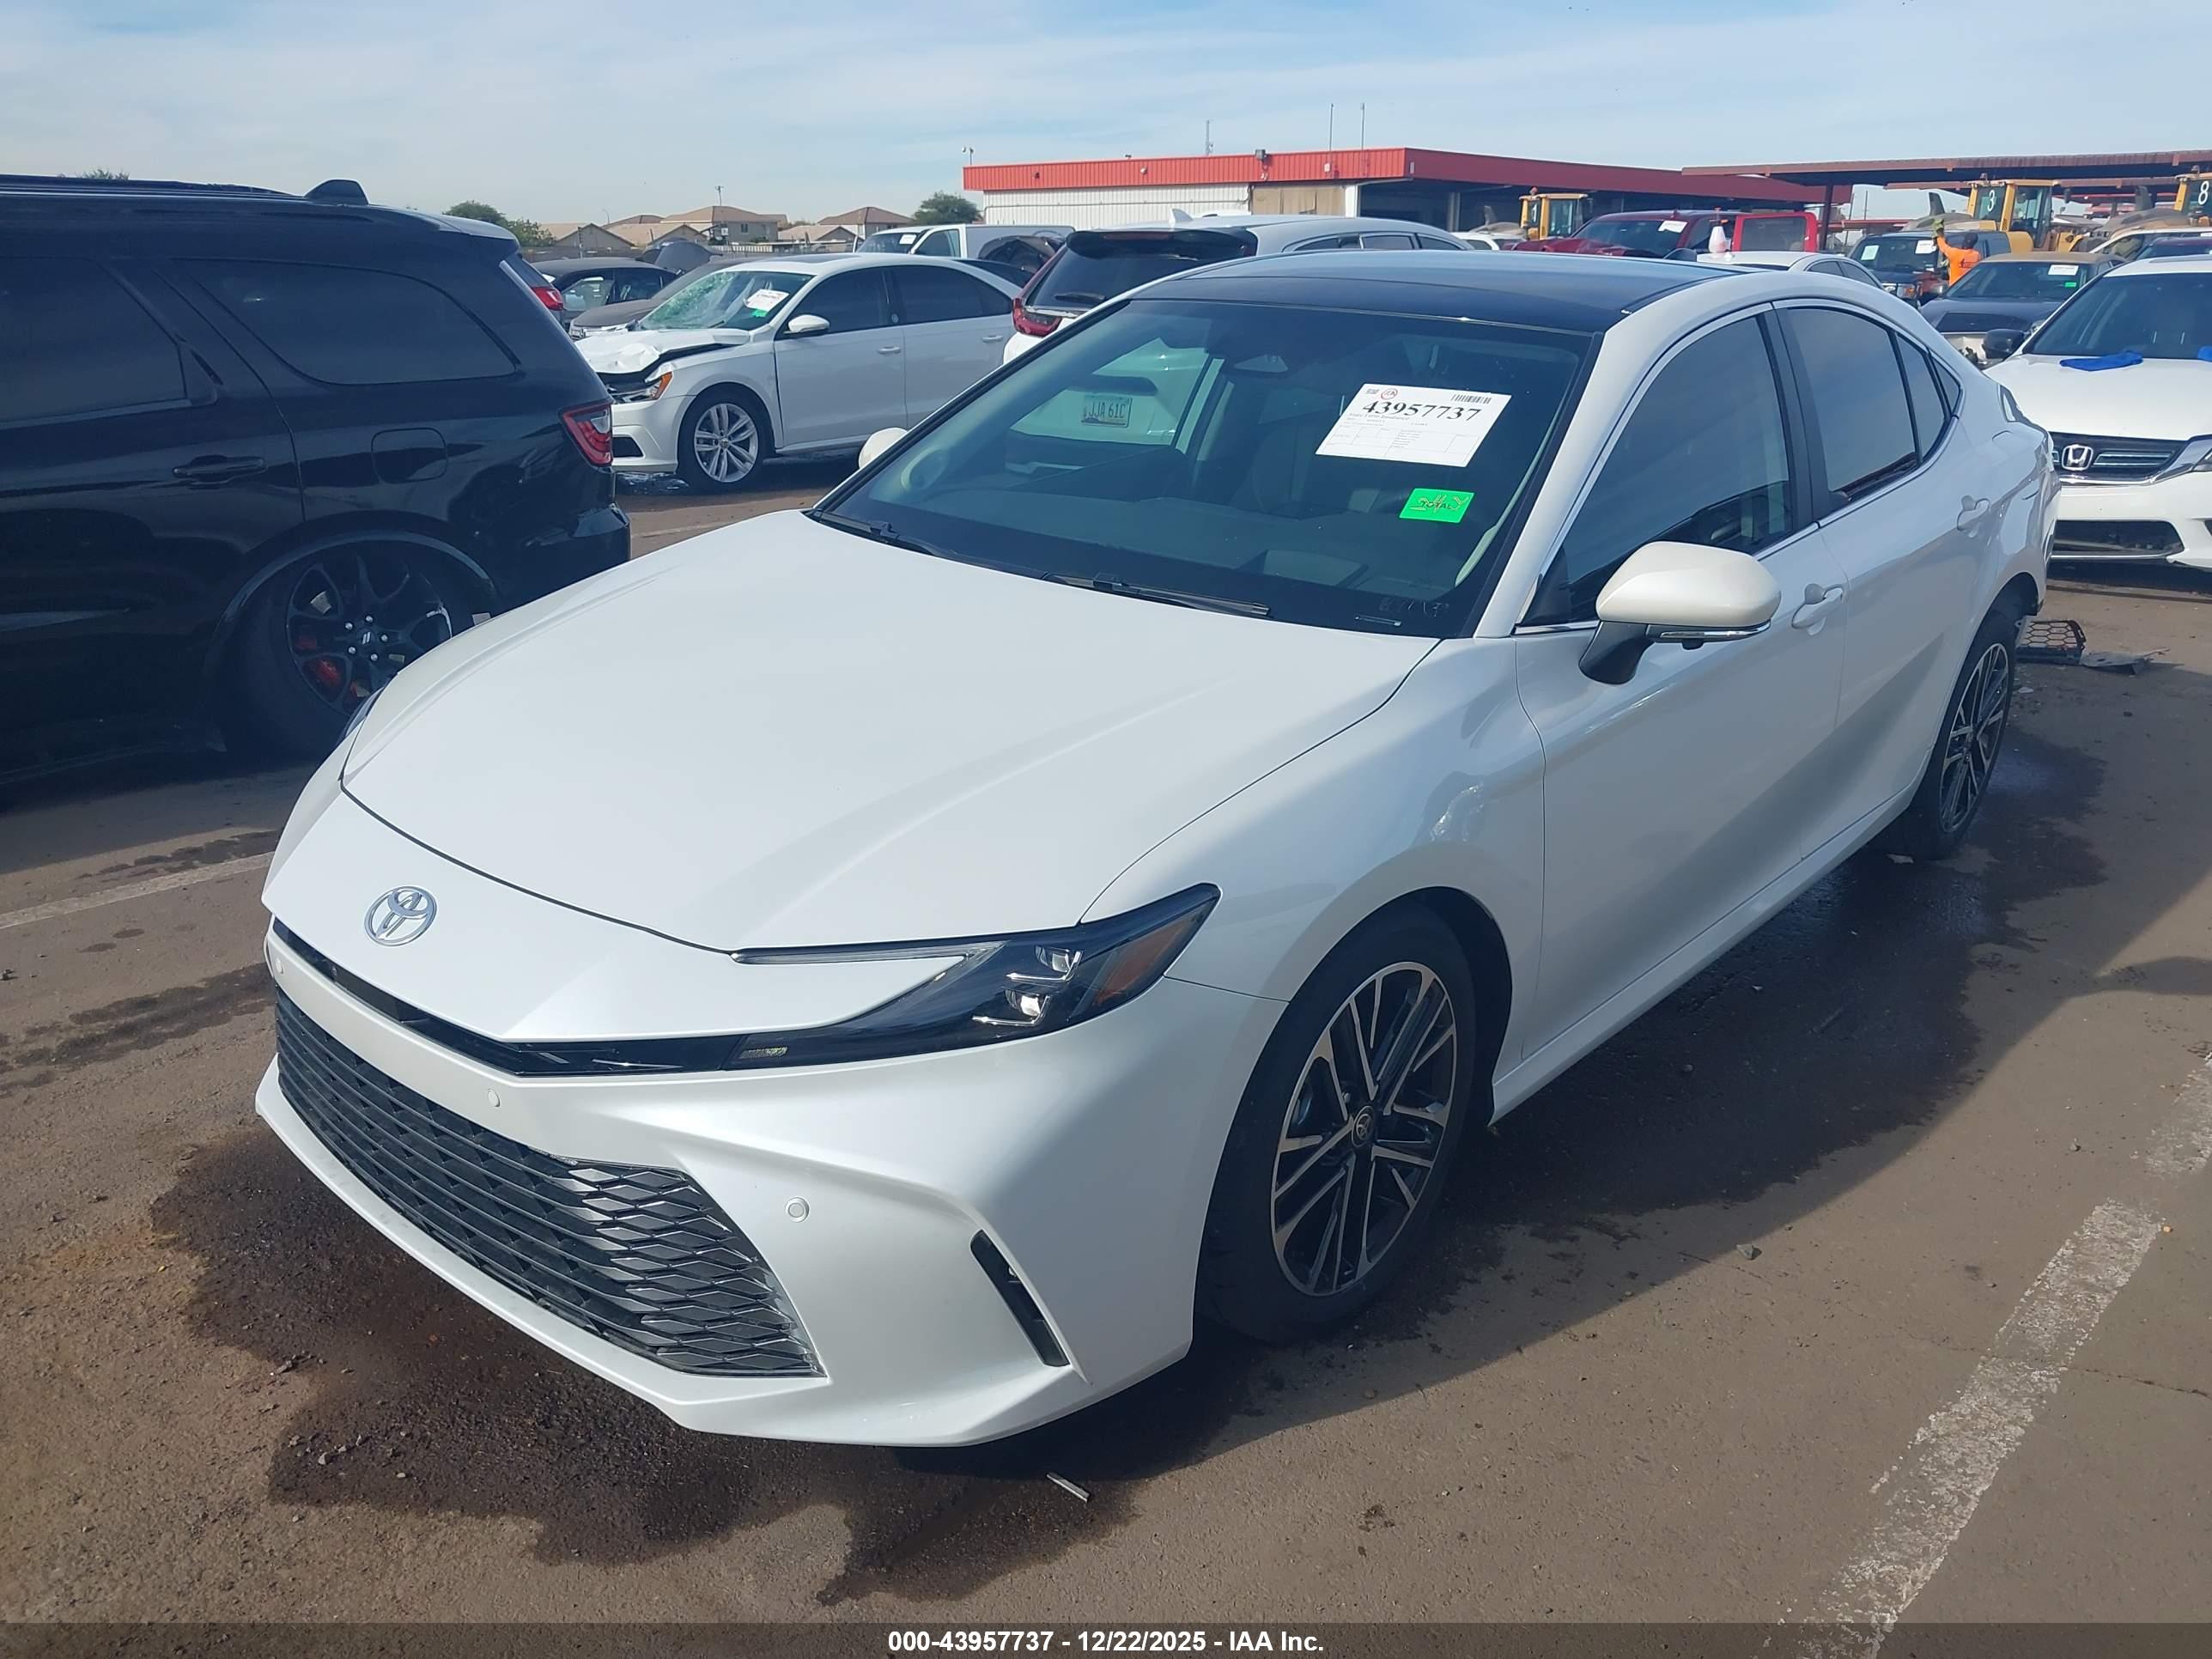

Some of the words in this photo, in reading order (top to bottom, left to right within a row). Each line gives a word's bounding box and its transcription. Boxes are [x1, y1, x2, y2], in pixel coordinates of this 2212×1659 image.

[1987, 189, 1995, 212] 3
[2198, 180, 2209, 205] 8
[1362, 400, 1482, 422] 43957737
